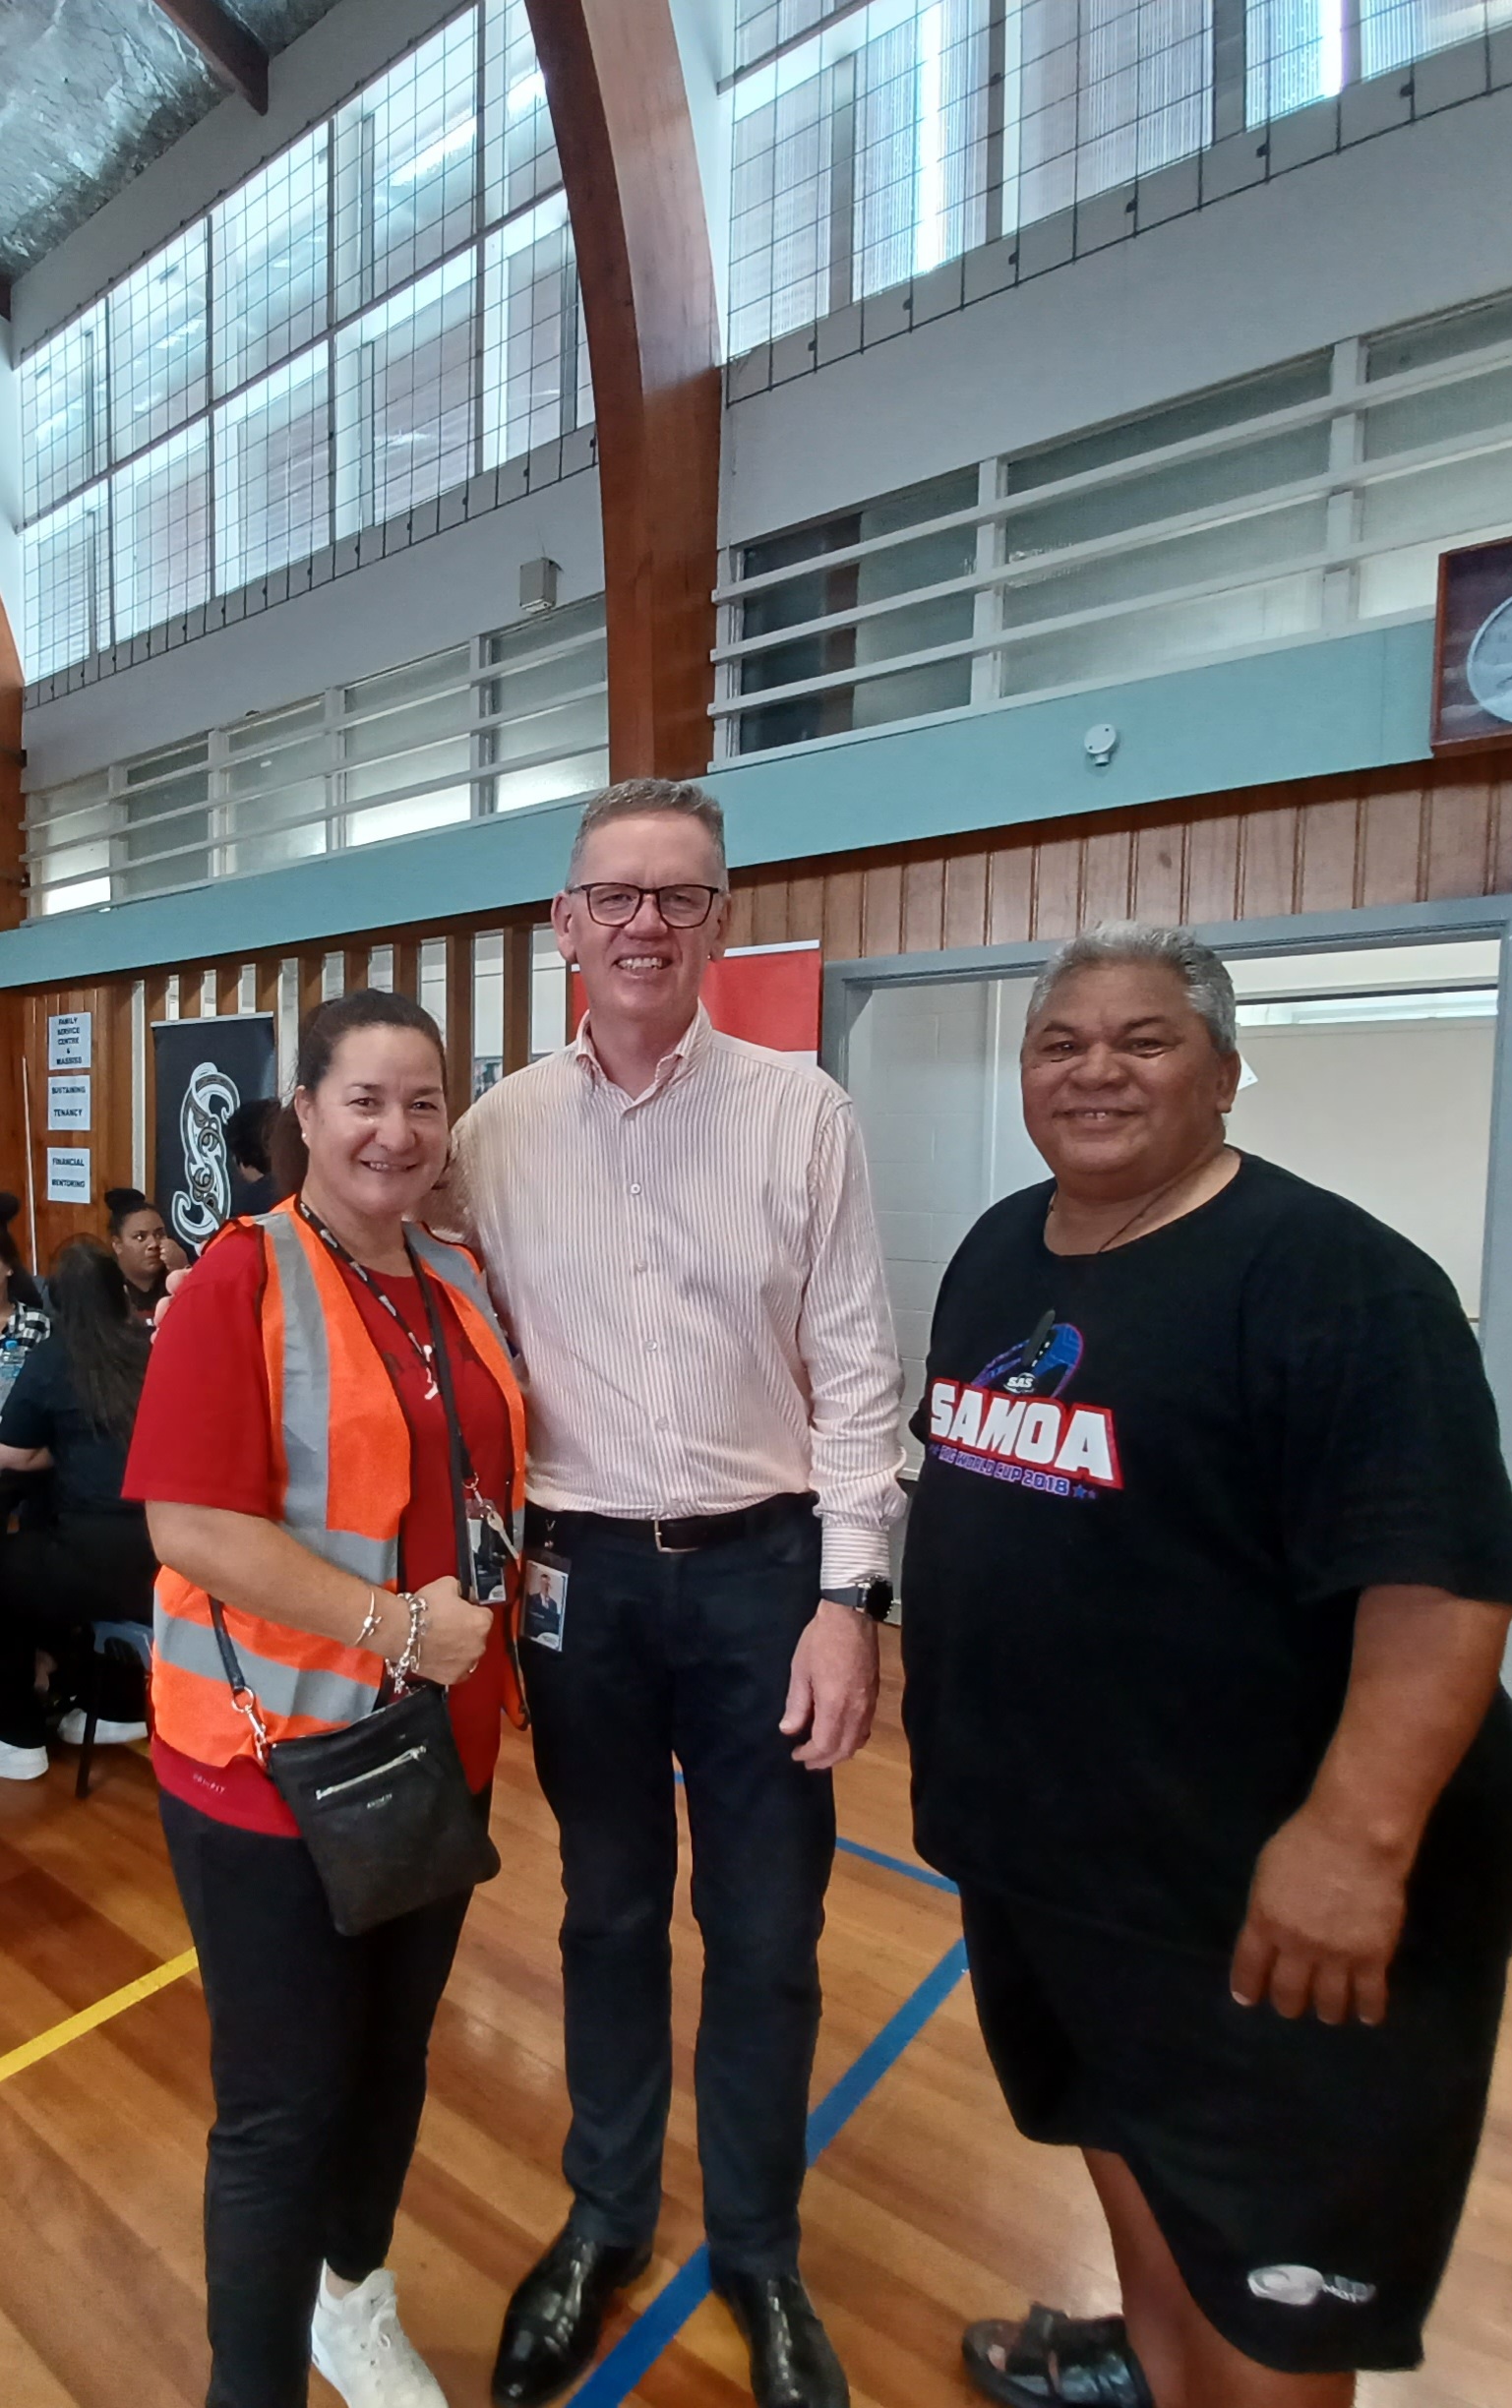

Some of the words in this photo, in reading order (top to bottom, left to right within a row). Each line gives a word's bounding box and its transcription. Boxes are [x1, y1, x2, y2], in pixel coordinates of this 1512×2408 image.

[52, 1158, 85, 1167] FINANCIAL
[1006, 1376, 1034, 1388] SAS
[930, 1379, 1118, 1483] SAMOA
[955, 1450, 996, 1476] WORLD
[994, 1462, 1023, 1483] CUP
[1021, 1469, 1070, 1496] 2018
